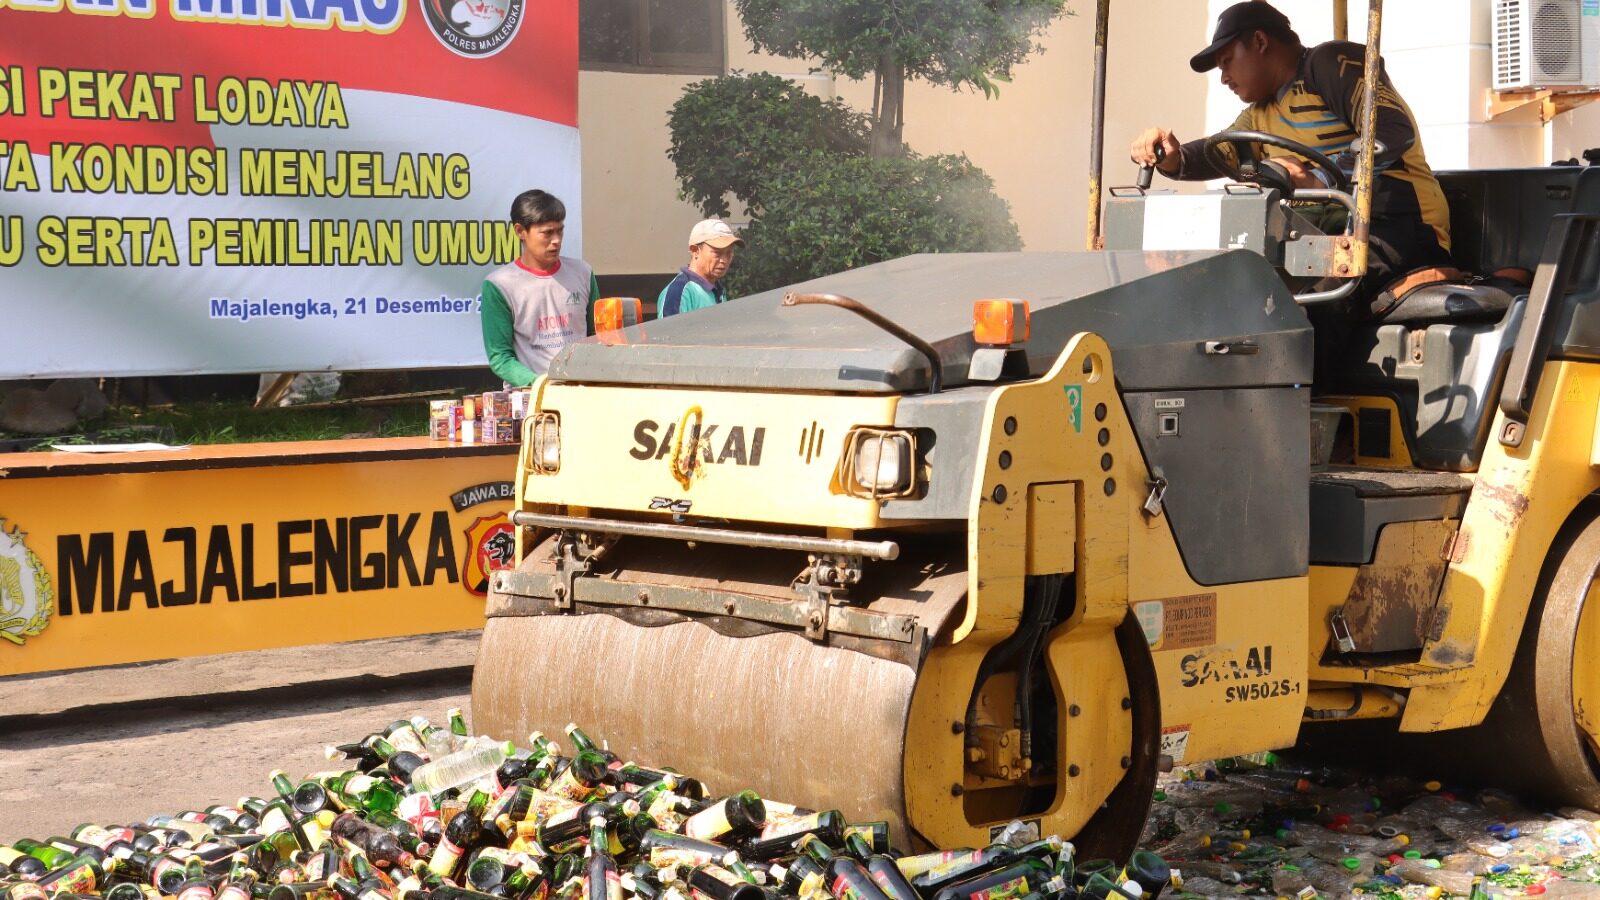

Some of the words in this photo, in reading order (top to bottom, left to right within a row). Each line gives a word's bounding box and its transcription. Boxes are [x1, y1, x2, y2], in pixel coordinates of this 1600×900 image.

[443, 28, 477, 50] POLRES
[479, 4, 520, 50] MAJALENGKA
[38, 67, 181, 122] PEKAT
[193, 75, 349, 128] LODAYA
[51, 142, 229, 195] KONDISI
[239, 150, 472, 199] MENJELANG
[36, 215, 179, 267] SERTA
[189, 217, 403, 266] PEMILIHAN
[413, 220, 521, 266] UMUM
[211, 298, 339, 320] Majalengka,
[345, 299, 369, 314] 21
[376, 297, 472, 315] Desember
[461, 485, 497, 507] JAWA
[57, 511, 460, 616] MAJALENGKA
[1225, 679, 1301, 703] SW502S-1
